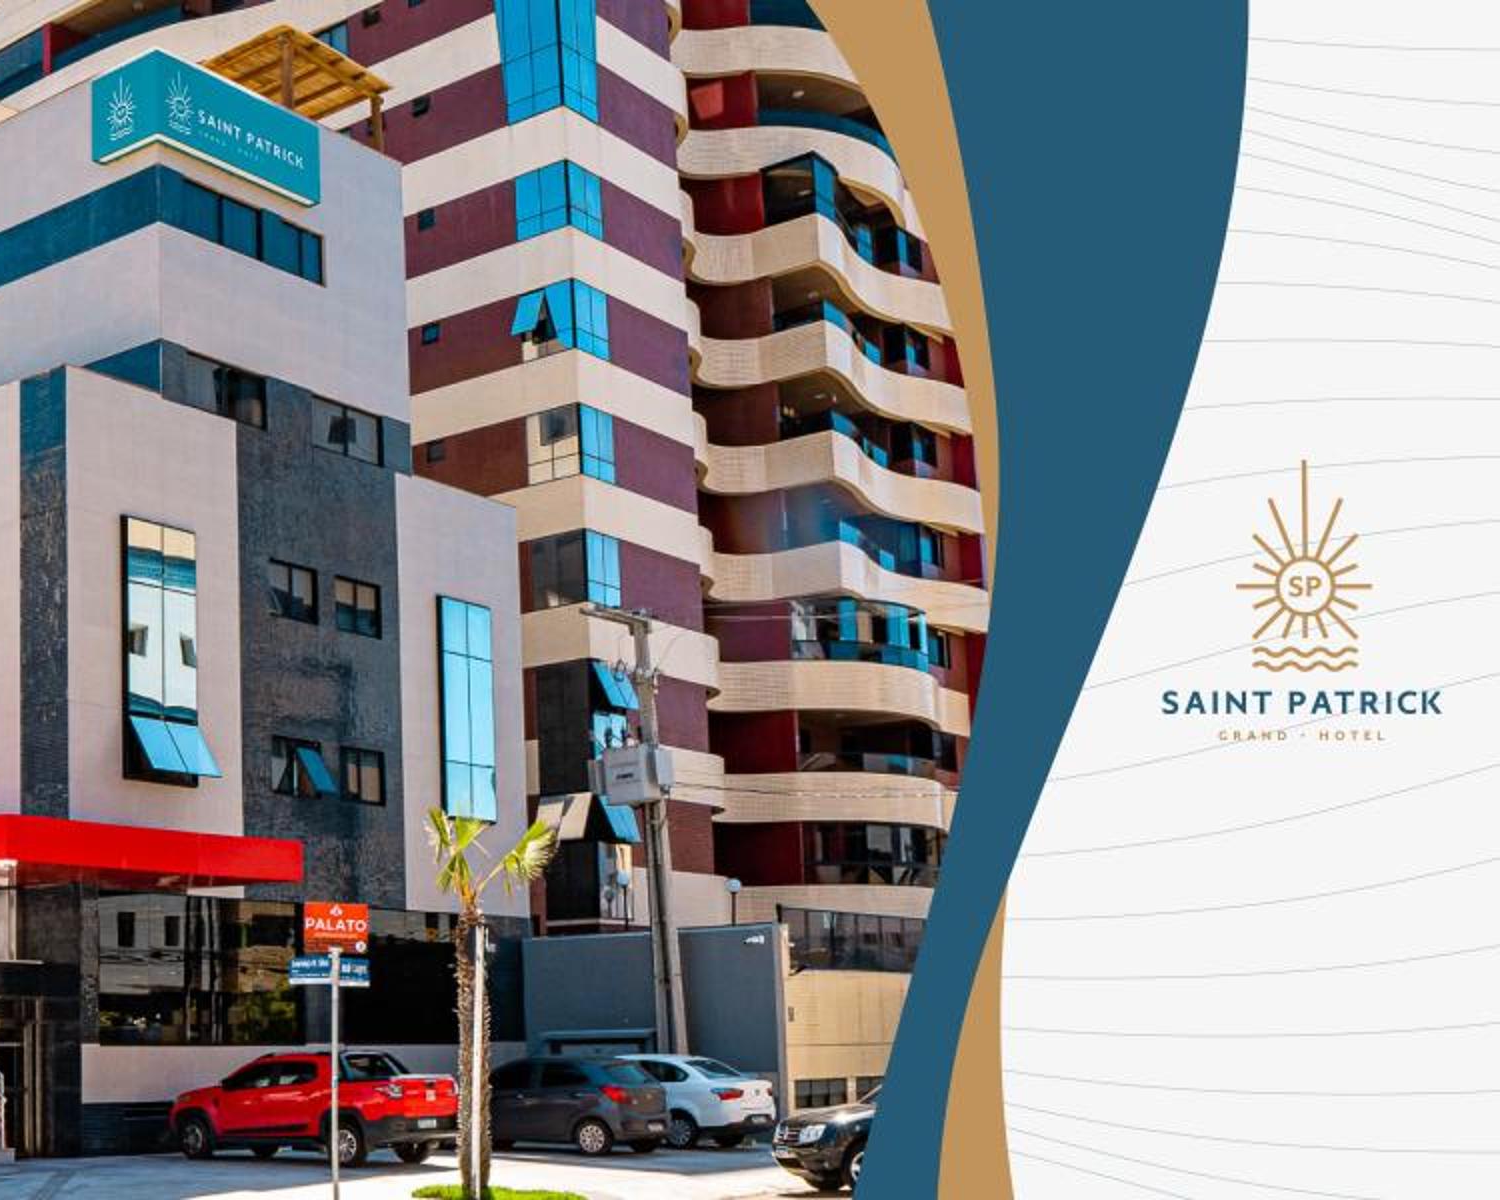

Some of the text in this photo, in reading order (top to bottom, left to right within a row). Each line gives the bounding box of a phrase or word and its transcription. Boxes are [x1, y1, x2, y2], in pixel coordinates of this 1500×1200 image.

[197, 110, 242, 141] SAINT
[246, 132, 305, 170] PATRICK
[304, 917, 367, 931] PALATO
